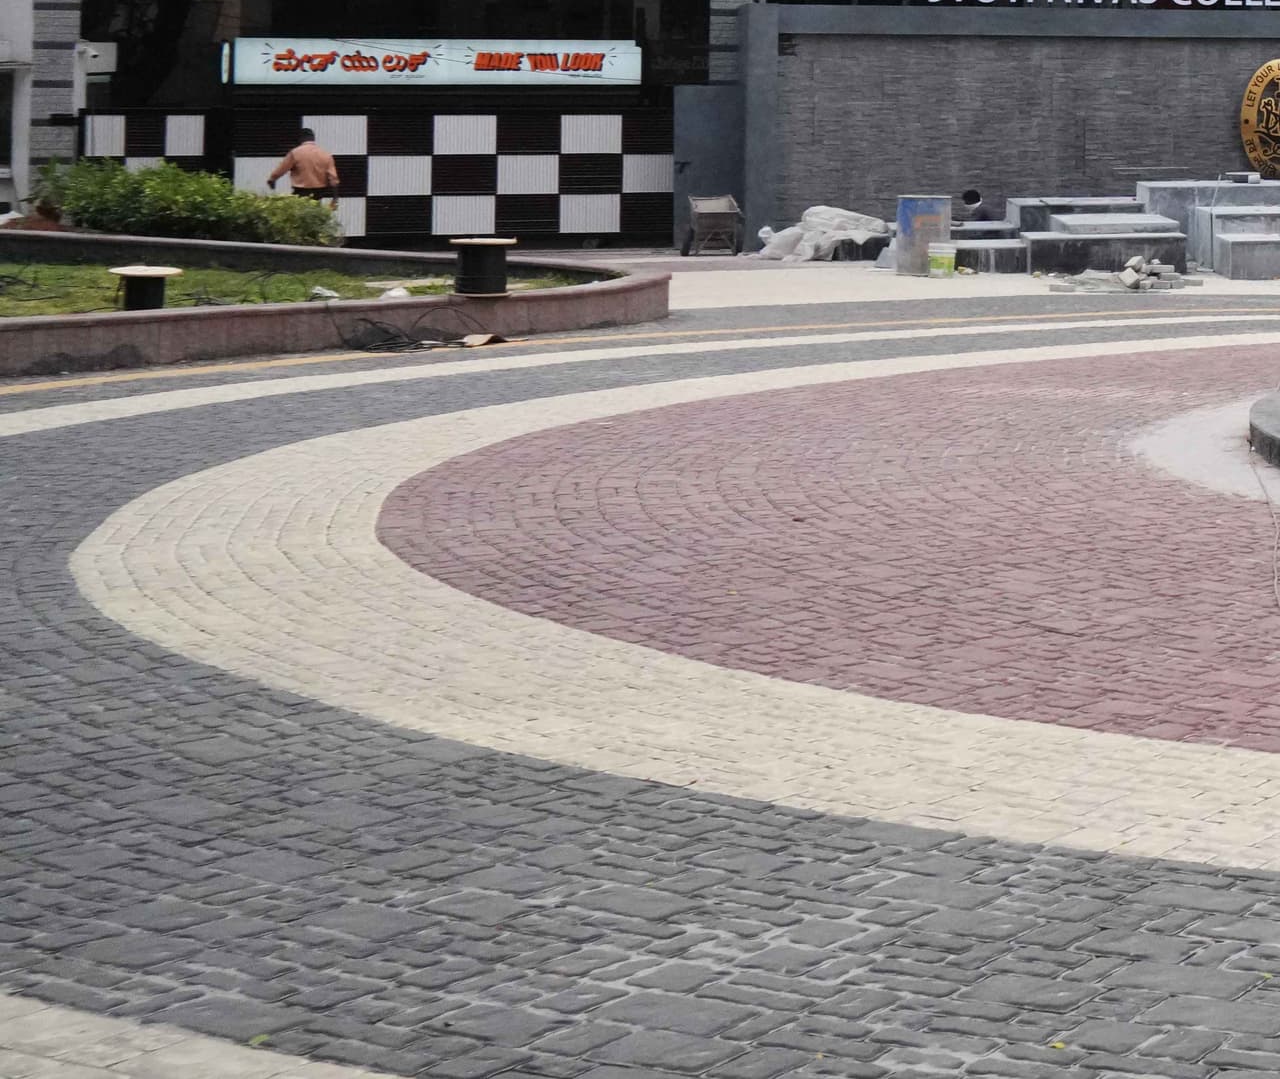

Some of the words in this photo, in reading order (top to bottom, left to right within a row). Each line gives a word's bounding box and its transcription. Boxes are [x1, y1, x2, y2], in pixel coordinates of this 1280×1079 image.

[474, 52, 524, 71] MADE
[526, 53, 559, 72] YOU
[560, 53, 605, 72] LOOK
[1246, 90, 1256, 108] LET
[1252, 64, 1275, 88] YOUR
